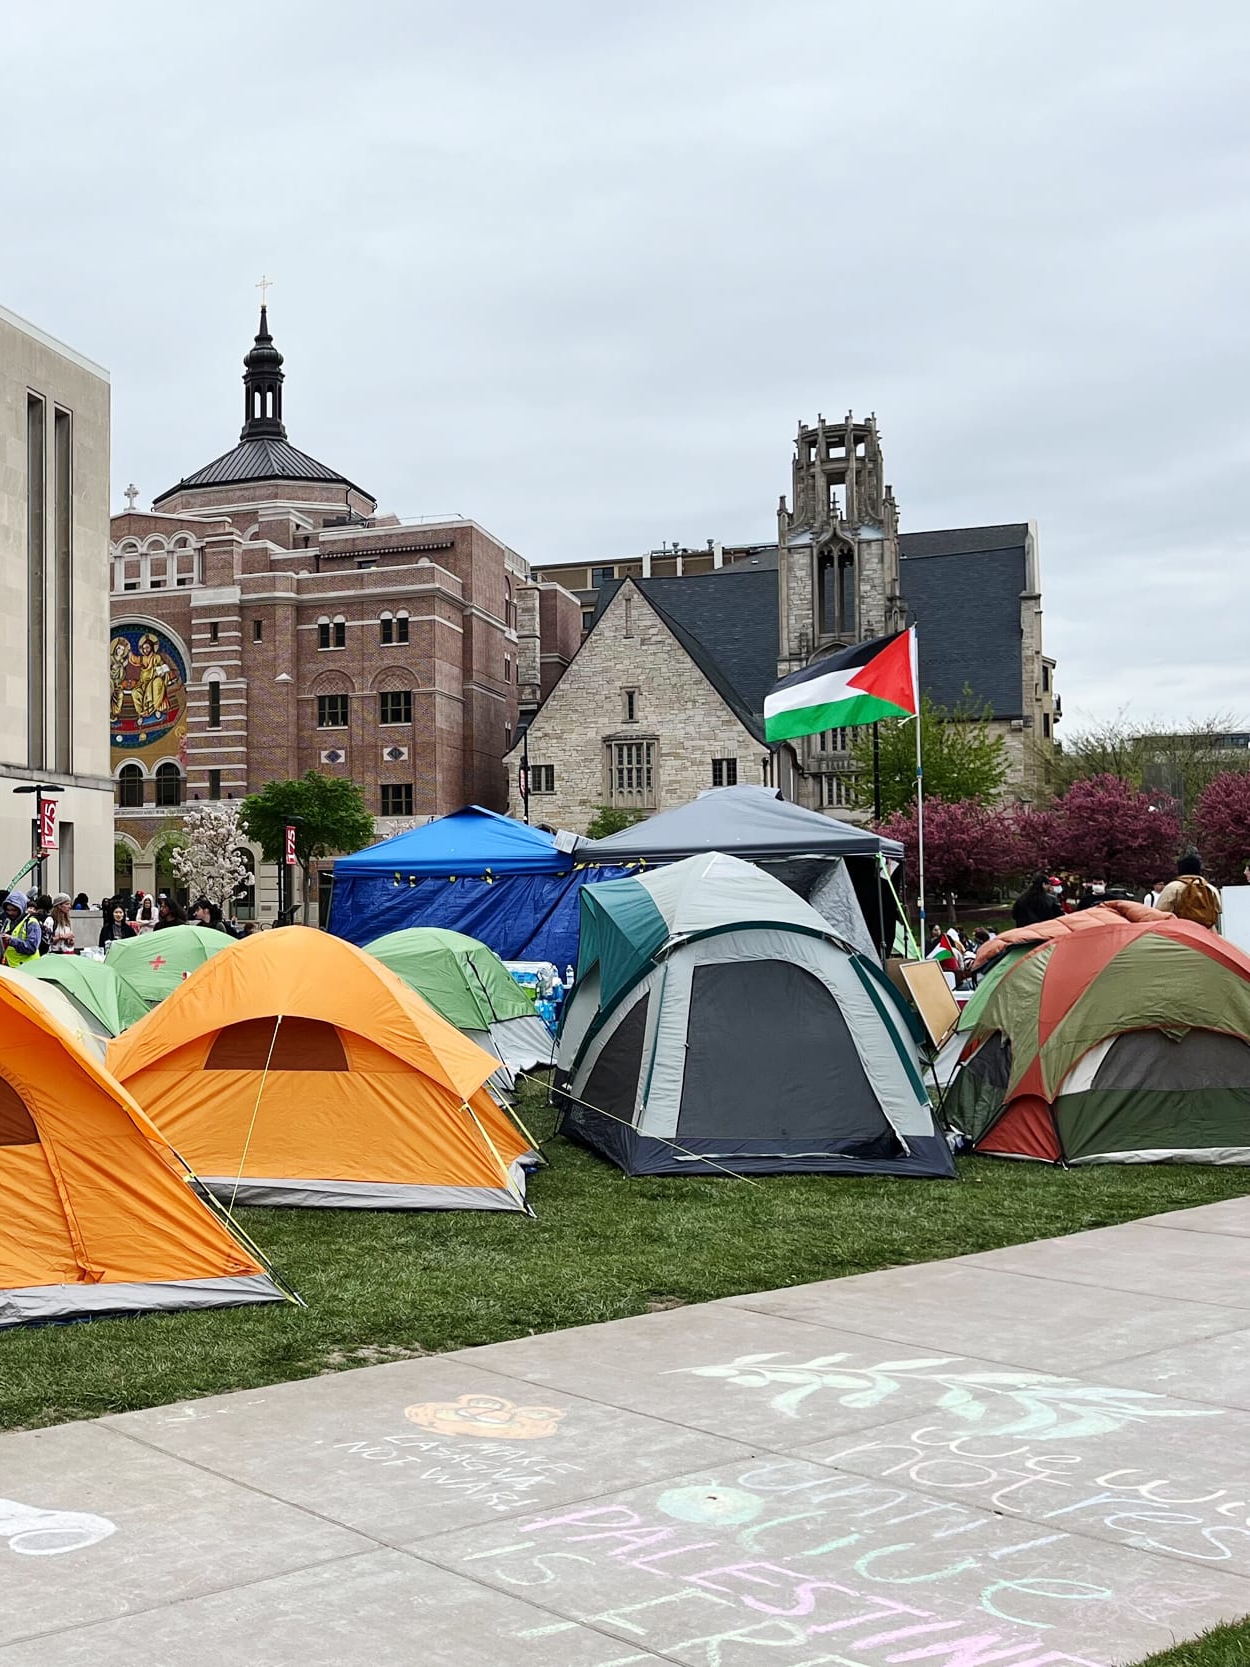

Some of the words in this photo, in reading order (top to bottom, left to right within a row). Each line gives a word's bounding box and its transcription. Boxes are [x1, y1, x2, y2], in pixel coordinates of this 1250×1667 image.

[44, 803, 57, 846] 175
[287, 829, 296, 862] 175
[459, 1443, 583, 1475] MAKE
[911, 1426, 1082, 1475] we
[333, 1441, 421, 1466] NOT
[421, 1467, 539, 1511] WAR!
[826, 1441, 1072, 1513] not
